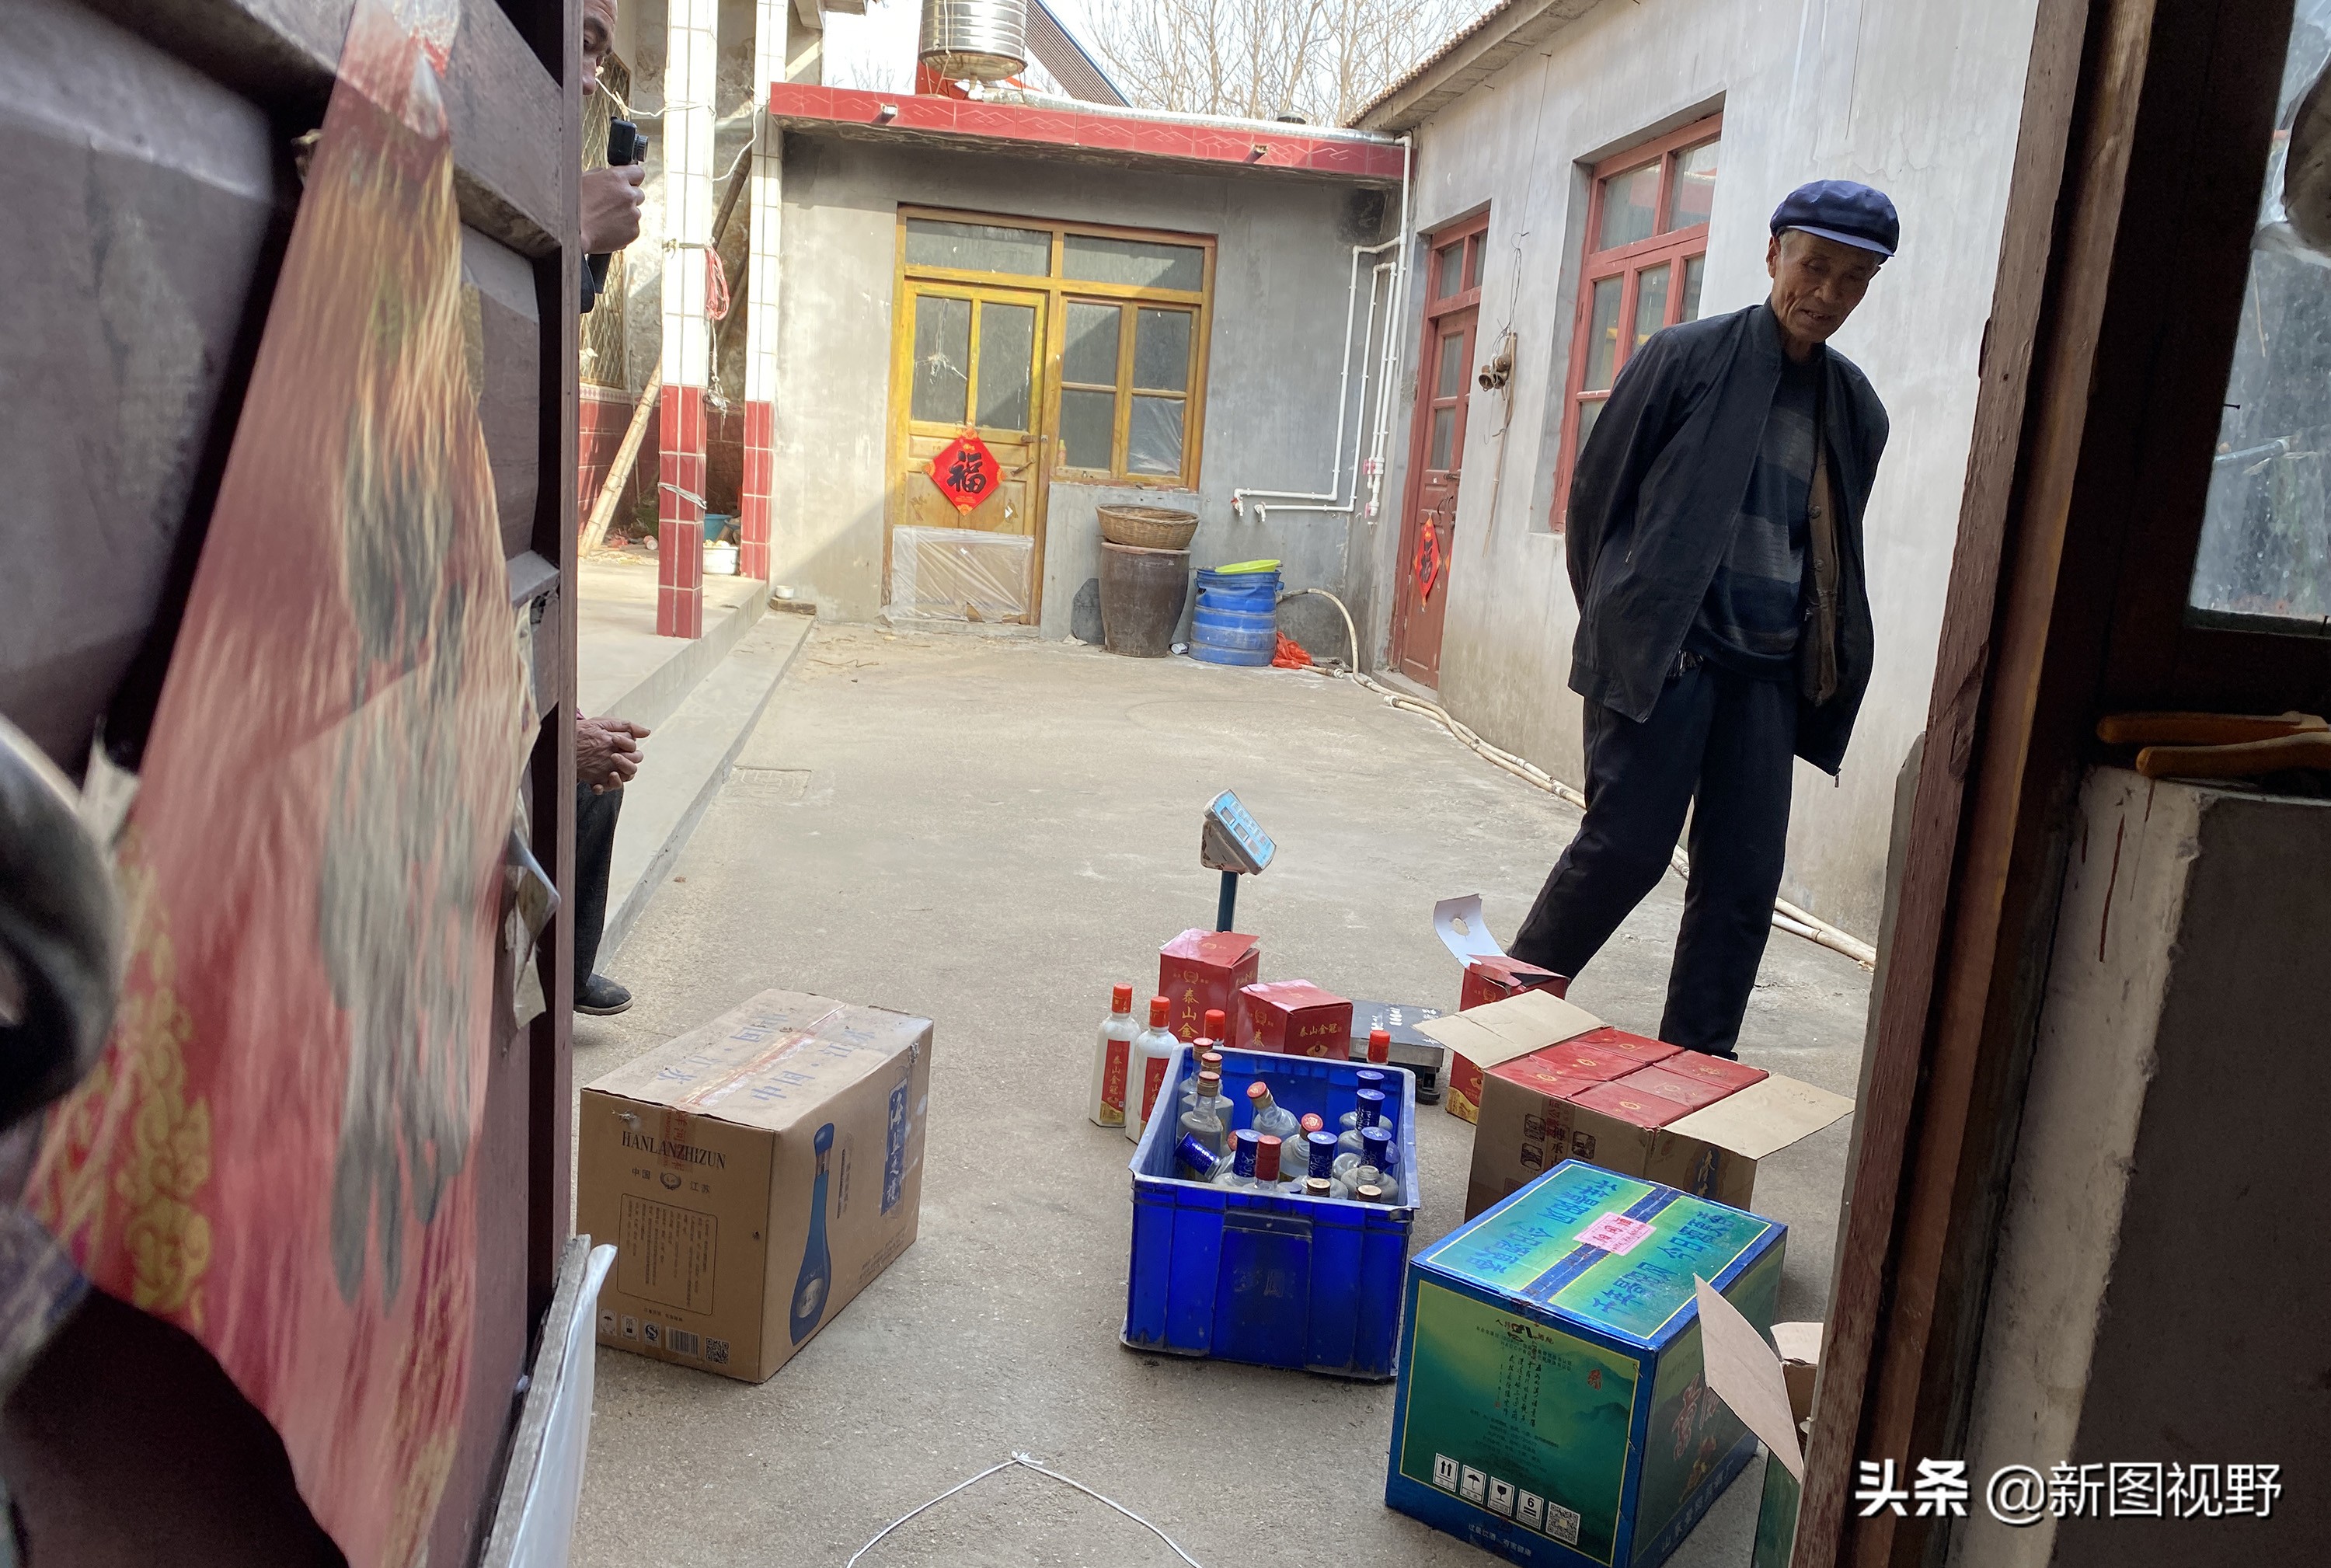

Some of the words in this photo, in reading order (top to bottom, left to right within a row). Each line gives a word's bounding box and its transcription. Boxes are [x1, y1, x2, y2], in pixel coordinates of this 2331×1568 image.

[946, 450, 987, 494] 福
[1420, 539, 1434, 584] 福
[1178, 987, 1200, 1043] 泰山金
[1299, 1023, 1339, 1038] 泰山金冠
[1109, 1054, 1124, 1096] 泰山金冠
[1148, 1071, 1162, 1112] 泰山金
[622, 1131, 727, 1169] HANLANZHIZUN
[631, 1166, 651, 1180] 中国
[689, 1180, 711, 1194] 江苏
[1527, 1497, 1535, 1508] 6
